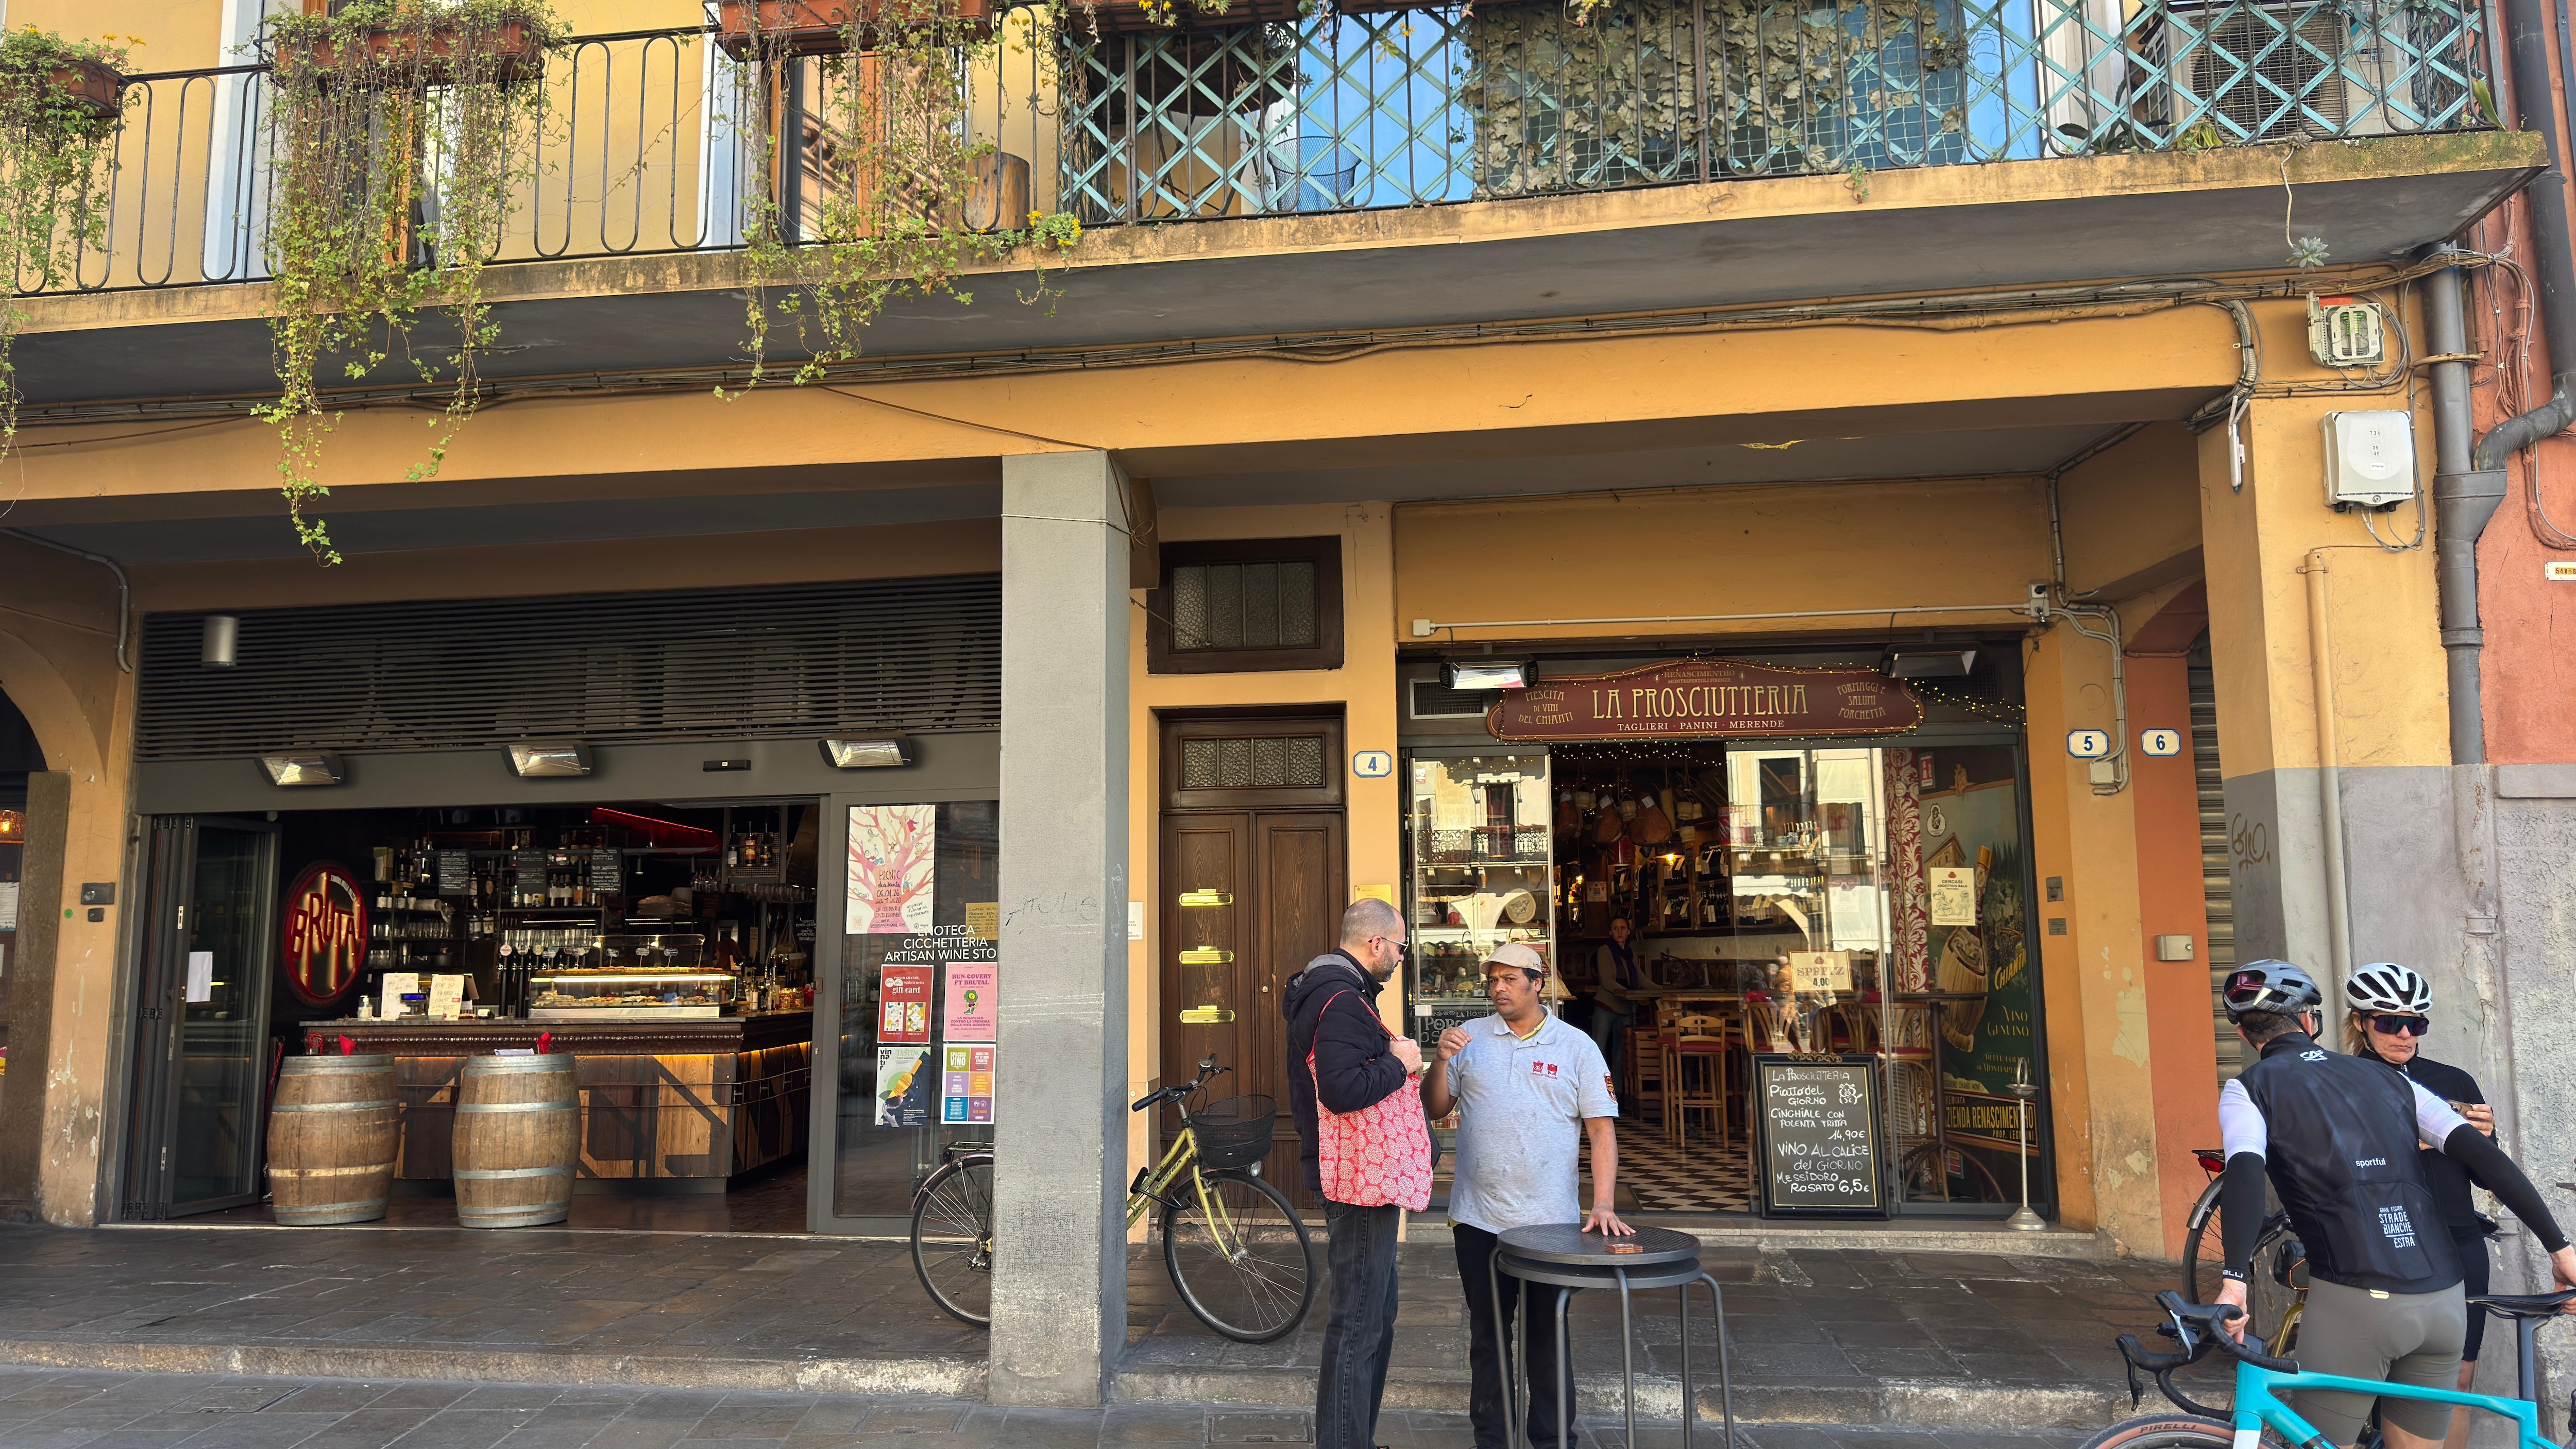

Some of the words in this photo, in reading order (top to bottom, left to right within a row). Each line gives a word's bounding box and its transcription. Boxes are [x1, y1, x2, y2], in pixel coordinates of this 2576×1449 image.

[1664, 670, 1735, 678] RENASCIMENTHO
[1836, 682, 1878, 695] FORMAGGI
[1880, 686, 1886, 694] E
[1525, 690, 1565, 701] MESCITA
[1848, 695, 1876, 706] SALUMI
[1542, 704, 1558, 712] VINI
[1592, 689, 1622, 719] LA
[1632, 685, 1809, 718] PROSCIUTTERIA
[1518, 714, 1533, 724] DEL
[1536, 712, 1573, 725] CHIANTI
[1838, 707, 1887, 720] PORCHETTA
[1617, 722, 1668, 731] TAGLIERI
[1680, 721, 1718, 729] PANINI
[1729, 720, 1784, 729] MERENDE
[2083, 736, 2093, 752] 5
[2156, 735, 2165, 751] 6
[1368, 757, 1377, 771] 4
[879, 870, 900, 880] PICNIC
[918, 925, 975, 937] ENOTECA
[904, 937, 988, 949] CICCHETTERIA
[885, 950, 935, 962] ARTISAN
[938, 949, 969, 960] WINE
[892, 986, 903, 995] gift
[2002, 1005, 2028, 1021] VINO
[1987, 1022, 2029, 1037] GENUINO
[951, 1058, 966, 1066] VINO
[1772, 1070, 1785, 1081] LA
[1804, 1085, 1824, 1096] del
[1771, 1108, 1820, 1119] CINGHIALE
[1827, 1110, 1844, 1118] CON
[1945, 1106, 1971, 1128] ZIENDA
[1972, 1105, 2033, 1129] RENASCIMENHO
[1780, 1119, 1816, 1128] POLENTA
[1777, 1141, 1807, 1157] VINO
[1811, 1144, 1830, 1156] AL
[1793, 1160, 1811, 1171] del
[2355, 1158, 2386, 1168] sportful
[1790, 1183, 1835, 1193] ROSATO
[2379, 1212, 2408, 1224] STRADE
[2383, 1222, 2413, 1234] BIANCHE
[2393, 1236, 2415, 1248] ESTRA
[2140, 1423, 2196, 1433] PIRELLI
